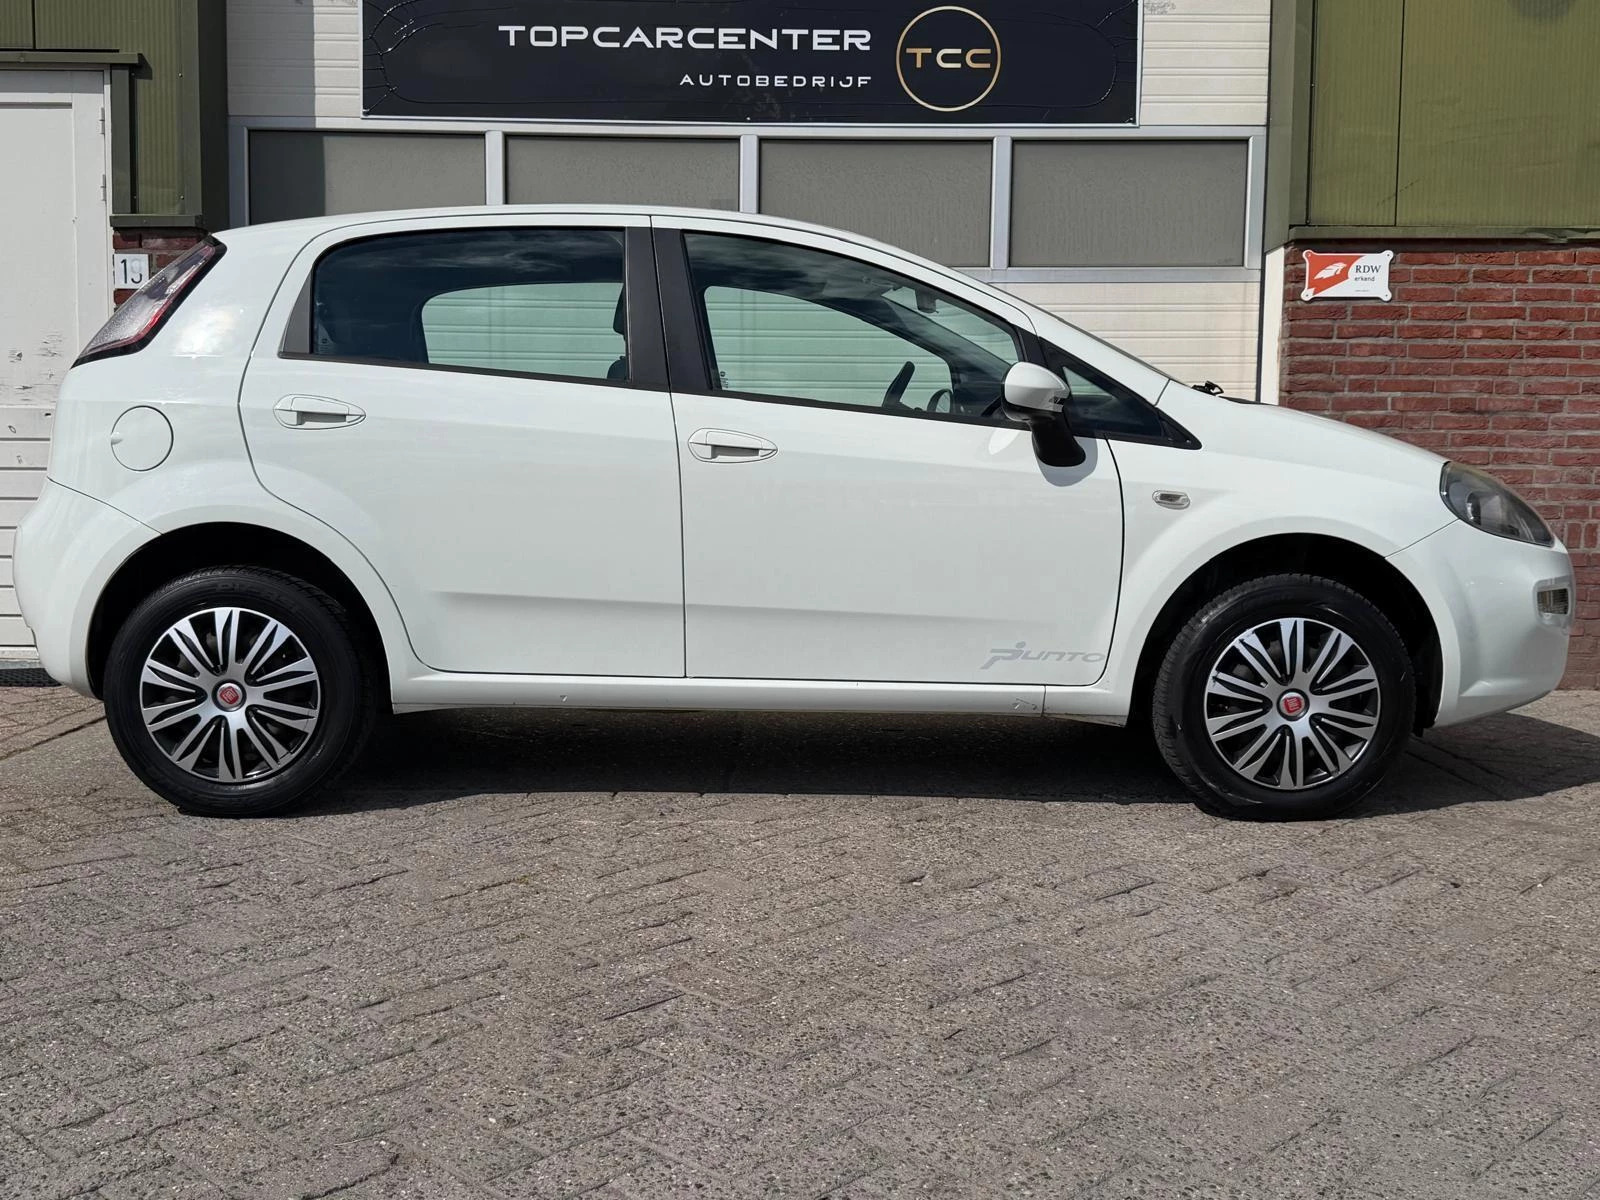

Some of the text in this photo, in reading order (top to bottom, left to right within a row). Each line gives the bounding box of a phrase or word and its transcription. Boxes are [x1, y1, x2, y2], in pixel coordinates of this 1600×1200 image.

[498, 25, 872, 51] TOPCARCENTER
[906, 47, 992, 68] TCC
[680, 74, 872, 88] AUTOBEDRIJF
[1355, 265, 1381, 274] RDW
